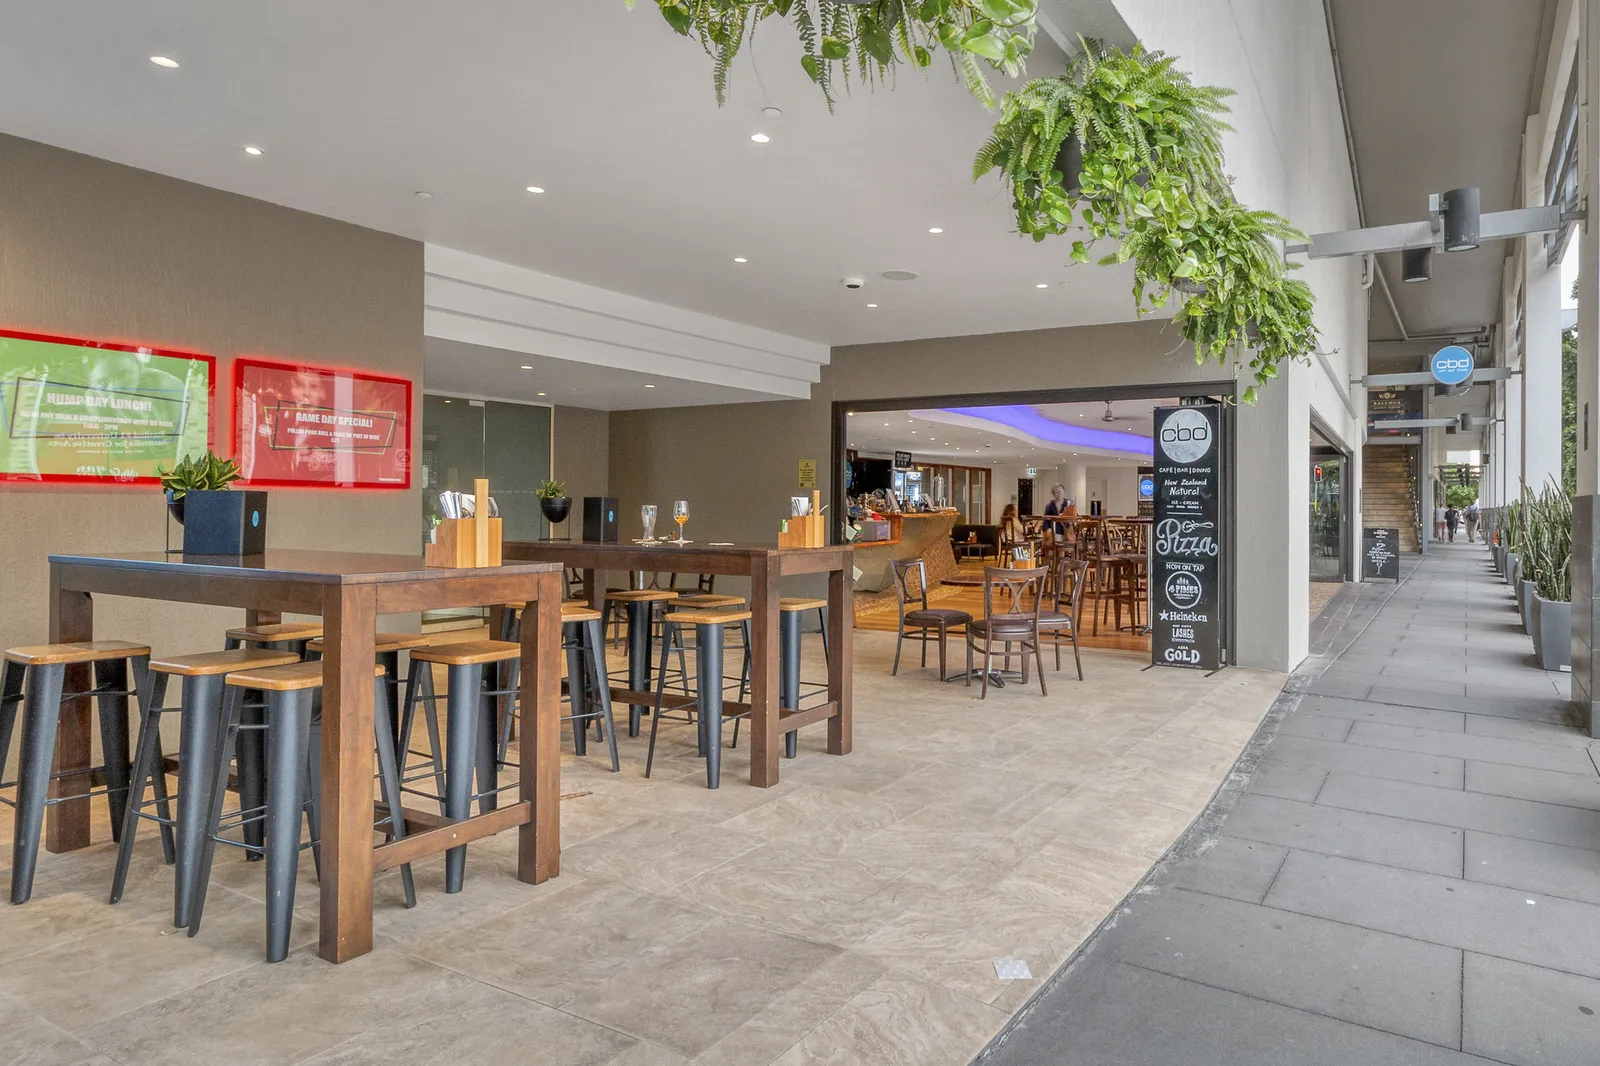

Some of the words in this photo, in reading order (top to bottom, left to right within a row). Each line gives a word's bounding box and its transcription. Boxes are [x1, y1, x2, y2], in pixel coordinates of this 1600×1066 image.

[1436, 357, 1469, 369] cbd
[47, 393, 83, 406] HUMP
[86, 395, 109, 408] DAY
[111, 398, 152, 412] LUNCH!
[295, 411, 320, 423] GAME
[321, 414, 337, 425] DAY
[338, 416, 373, 428] SPECIAL!
[1162, 421, 1208, 442] cbd
[1180, 478, 1207, 486] Zealand
[1169, 486, 1200, 496] Natural
[1156, 518, 1218, 556] Pizza
[1168, 584, 1175, 593] 4
[1175, 584, 1199, 594] PINES
[1169, 611, 1208, 622] Heineken
[1172, 627, 1194, 639] LASHES
[1164, 648, 1200, 664] GOLD
